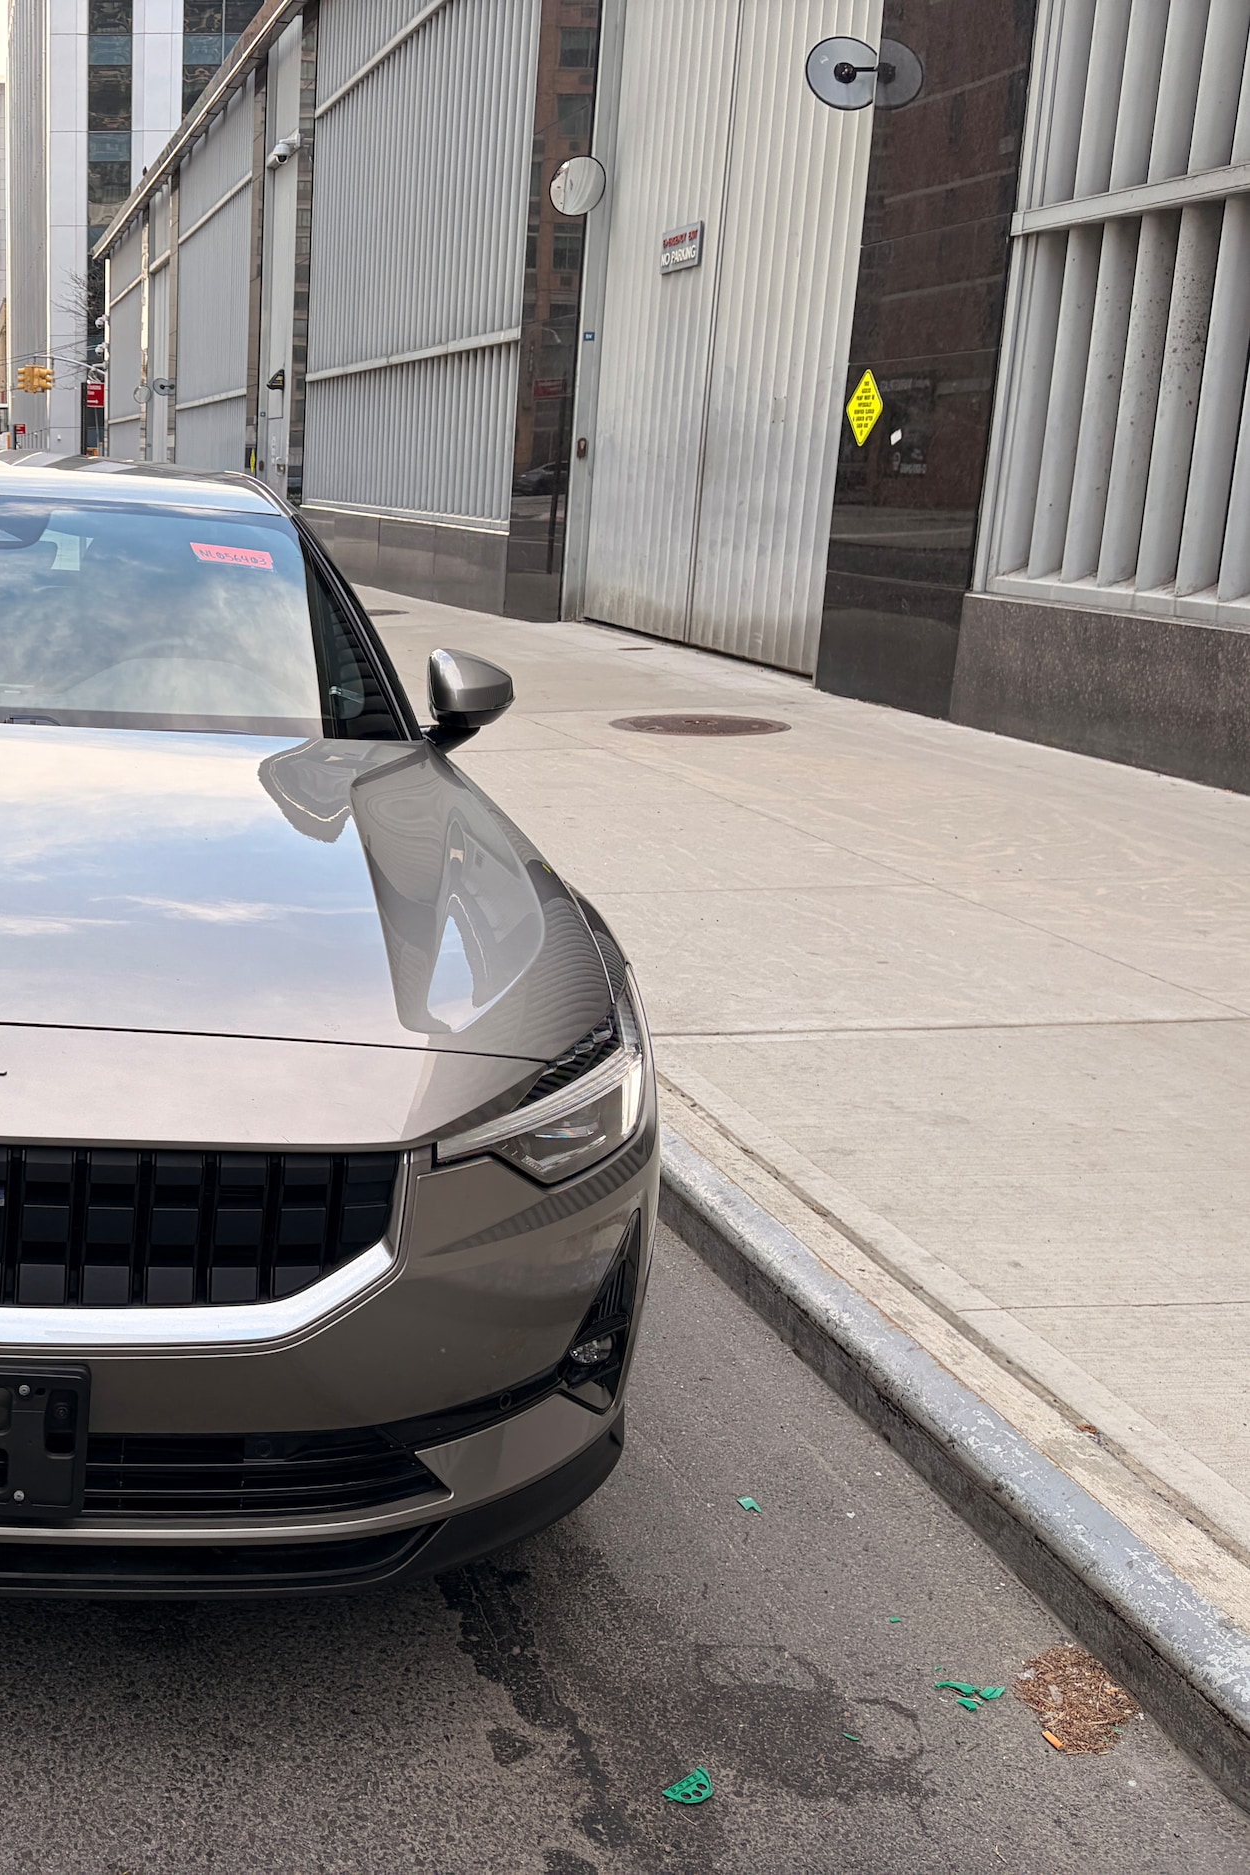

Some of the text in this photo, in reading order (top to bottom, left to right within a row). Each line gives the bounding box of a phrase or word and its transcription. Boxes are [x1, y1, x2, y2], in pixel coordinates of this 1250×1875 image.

[661, 245, 696, 267] NO PARKING
[198, 549, 267, 566] NL056403
